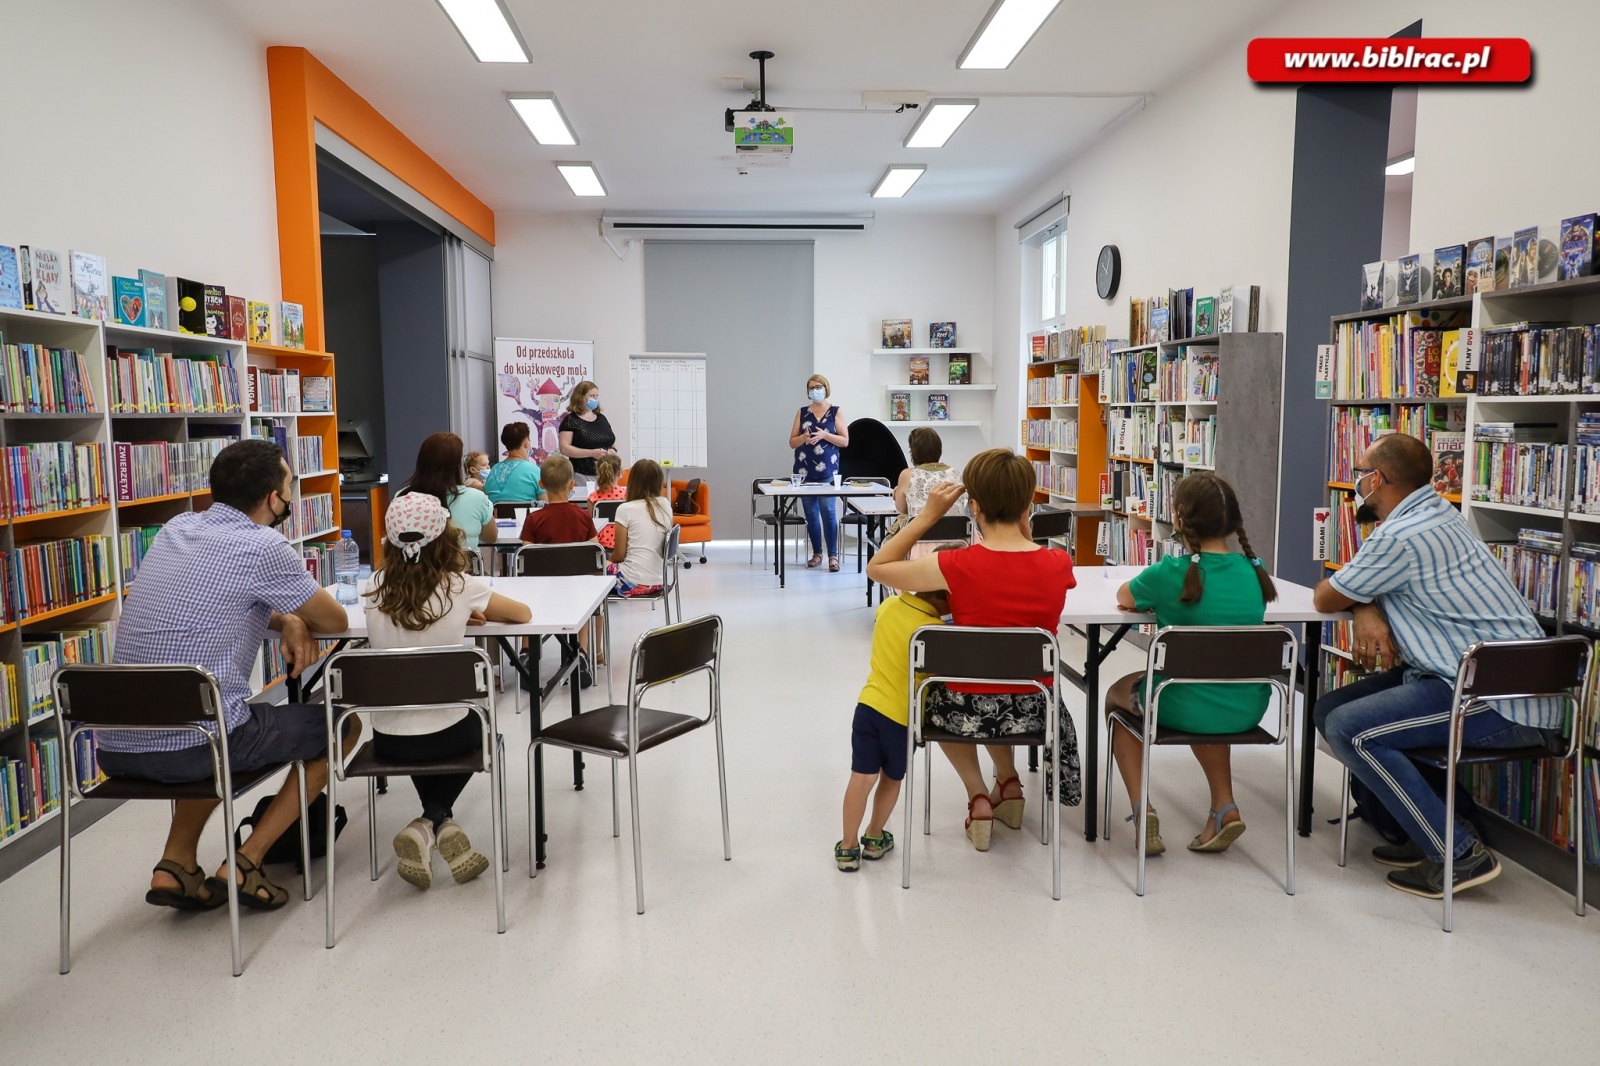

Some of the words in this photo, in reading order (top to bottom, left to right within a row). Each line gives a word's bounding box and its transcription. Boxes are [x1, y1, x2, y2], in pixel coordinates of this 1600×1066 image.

[516, 345, 527, 358] Od
[529, 347, 575, 361] przedszkola
[504, 362, 514, 375] do
[516, 363, 566, 378] książkowego
[567, 364, 588, 376] mola
[119, 445, 129, 495] ZWIERZĘTA
